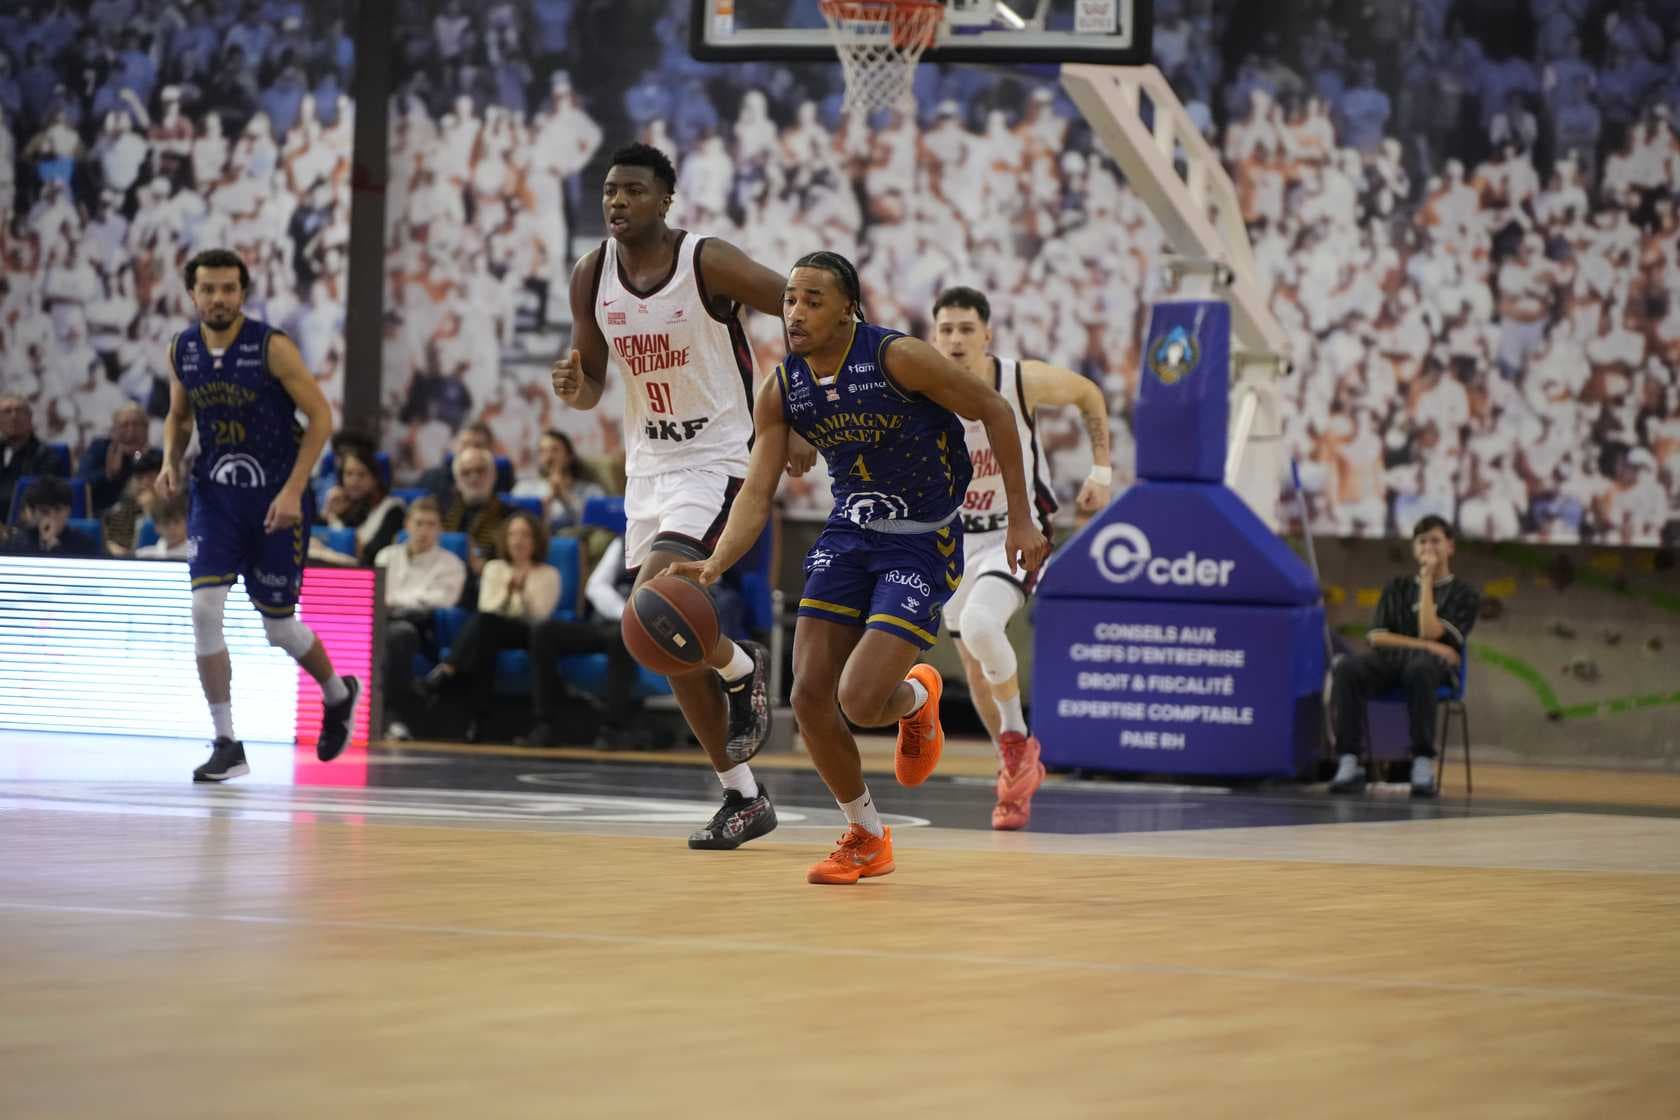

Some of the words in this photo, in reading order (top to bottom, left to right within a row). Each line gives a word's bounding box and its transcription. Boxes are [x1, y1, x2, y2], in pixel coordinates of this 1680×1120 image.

[613, 333, 670, 359] DENAIN
[625, 346, 690, 376] VOLTAIRE
[646, 382, 674, 415] 91
[211, 420, 247, 445] 20
[1147, 551, 1235, 586] cder
[1094, 622, 1178, 643] CONSEILS
[1180, 626, 1216, 645] AUX
[1069, 643, 1126, 662] CHEFS
[1127, 645, 1245, 667] D'ENTREPRISE
[1078, 672, 1129, 690] DROIT
[1131, 674, 1145, 690] &
[1148, 673, 1234, 695] FISCALITÉ
[1058, 699, 1146, 720] EXPERTISE
[1148, 702, 1254, 724] COMPTABLE
[1120, 730, 1158, 748] PAIE
[1160, 732, 1185, 749] RH
